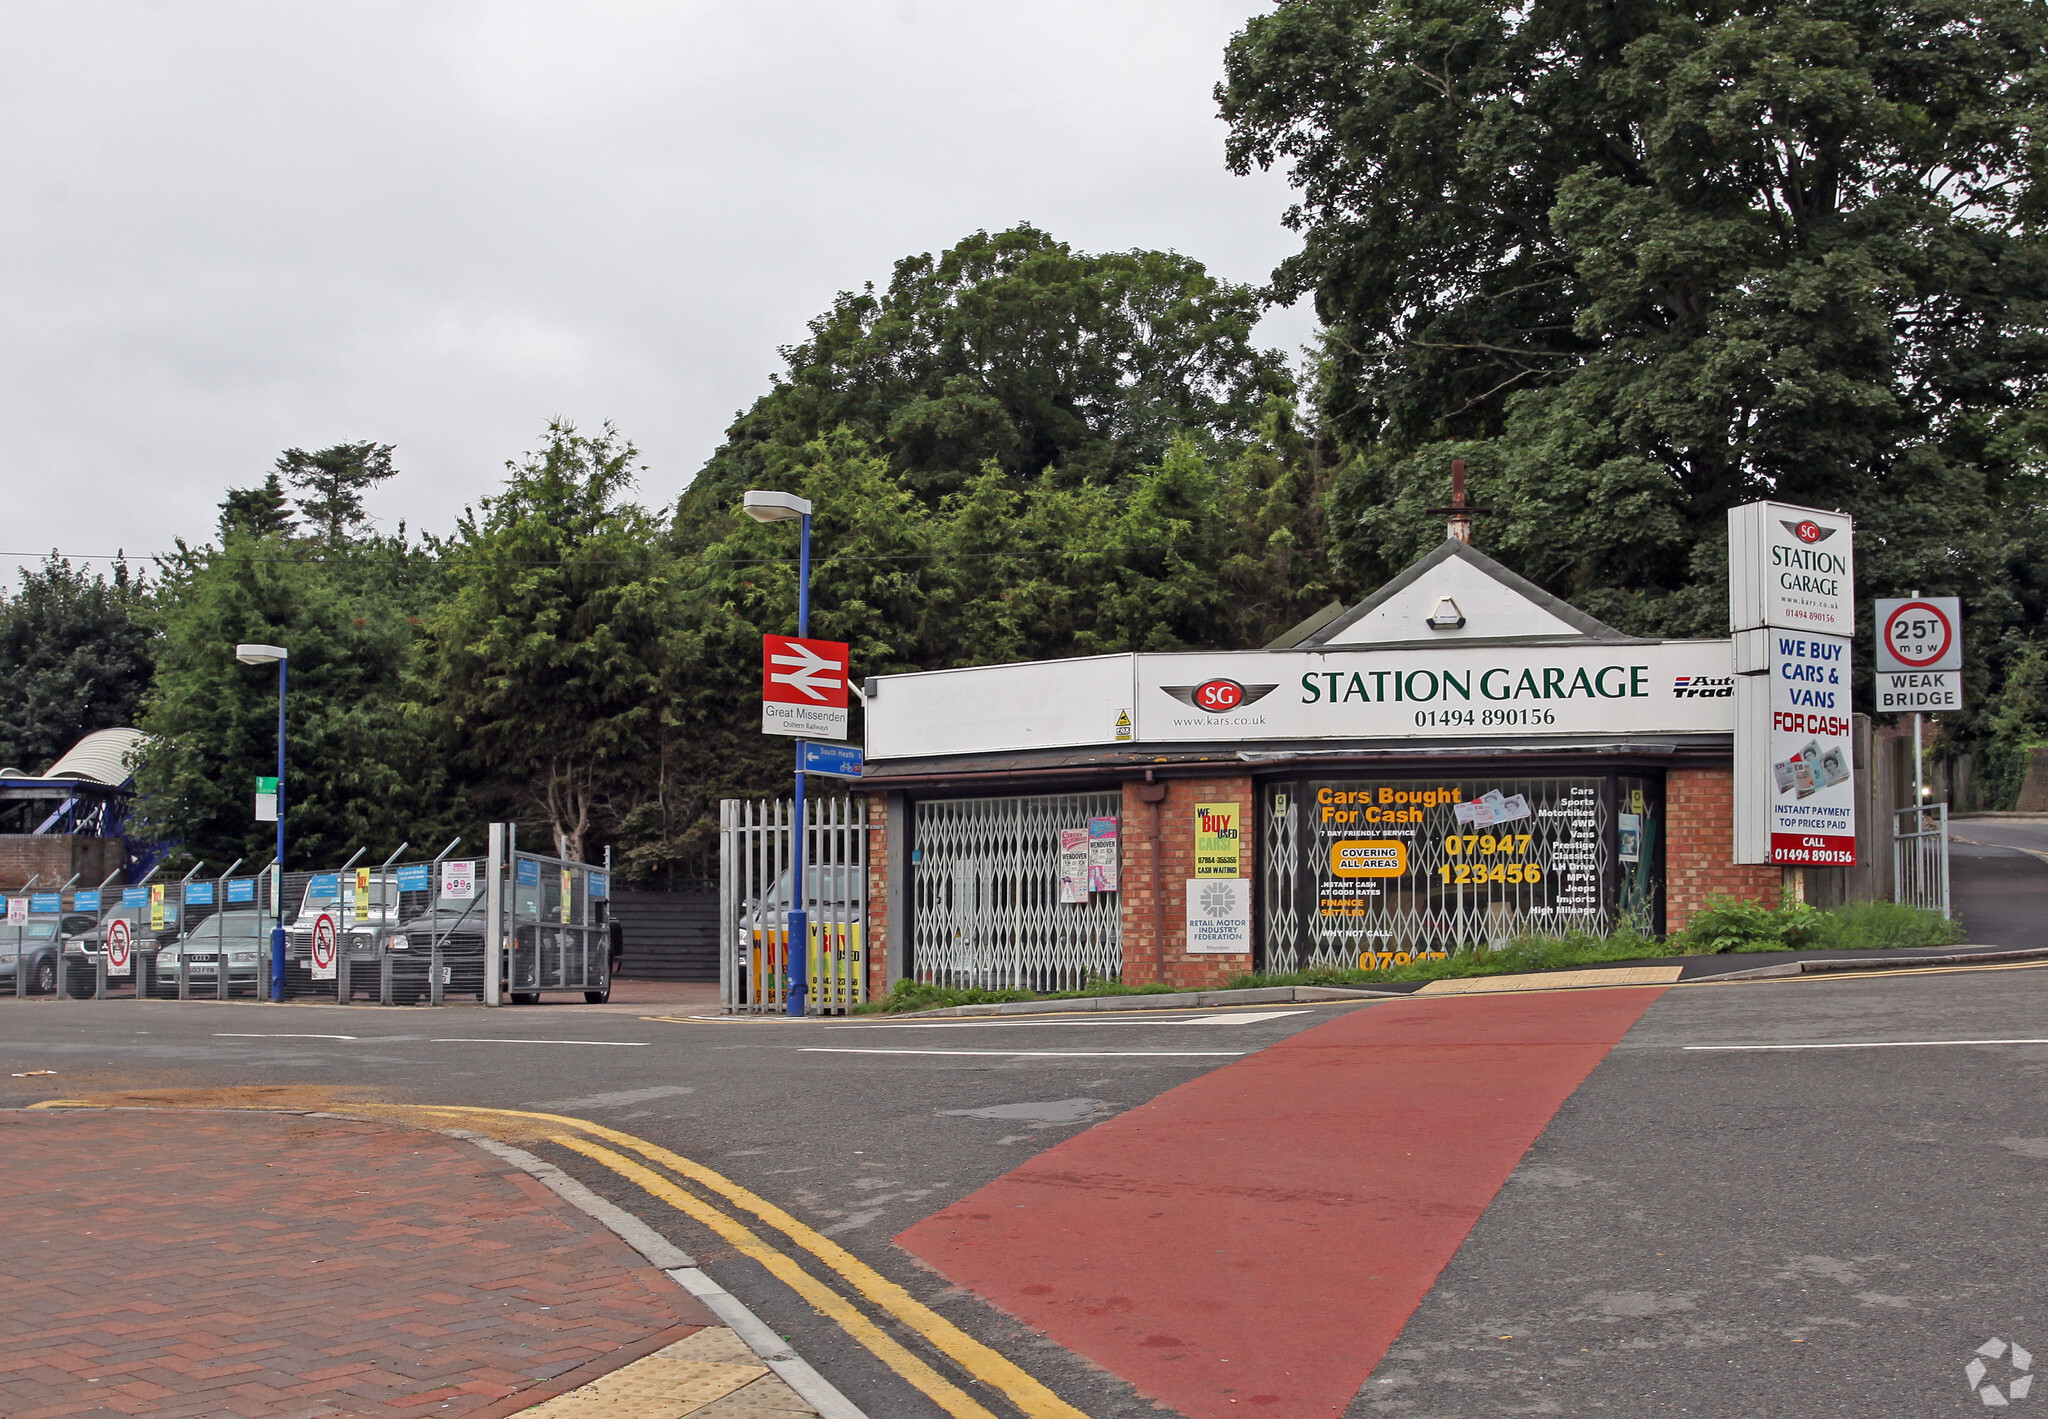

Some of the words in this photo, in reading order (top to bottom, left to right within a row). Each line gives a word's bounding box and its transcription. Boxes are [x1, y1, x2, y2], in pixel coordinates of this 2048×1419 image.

[1801, 525, 1815, 539] SG
[1772, 545, 1845, 576] STATION
[1781, 573, 1838, 596] GARAGE
[1781, 596, 1839, 610] www.kars.co.uk
[1785, 609, 1807, 619] 01494
[1809, 612, 1835, 622] 890156
[1779, 638, 1806, 657] WE
[1810, 642, 1842, 661] BUY
[1782, 663, 1823, 683] CARS
[1828, 667, 1839, 684] &
[1301, 669, 1471, 704] STATION
[1480, 665, 1649, 700] GARAGE
[1891, 674, 1945, 688] WEAK
[1205, 686, 1233, 704] SG
[1673, 687, 1734, 698] Trad
[1789, 688, 1835, 708] VANS
[1883, 692, 1954, 706] BRIDGE
[766, 705, 793, 718] Great
[796, 708, 845, 722] Missenden
[1415, 709, 1475, 727] 01494
[1482, 708, 1555, 726] 890156
[783, 721, 804, 729] Chiltern
[806, 723, 829, 731] Railways
[1173, 715, 1266, 726] www.kars.co.uk
[1774, 711, 1804, 733] FOR
[1807, 714, 1849, 737] CASH
[820, 747, 836, 756] South
[838, 750, 854, 759] Heath
[1317, 787, 1370, 804] Cars
[1378, 787, 1461, 808] Bought
[1570, 787, 1595, 795] Cars
[1561, 798, 1595, 807] Sports
[1197, 808, 1210, 818] WE
[1321, 806, 1358, 823] For
[1365, 806, 1423, 823] Cash
[1538, 809, 1595, 817] Motorbikes
[1774, 804, 1810, 815] INSTANT
[1812, 806, 1850, 817] PAYMENT
[1202, 815, 1231, 833] BUY
[1779, 818, 1796, 827] TOP
[1798, 819, 1825, 829] PRICES
[1827, 821, 1846, 830] PAID
[1218, 829, 1237, 839] USED
[1199, 838, 1231, 851] CARS!
[1445, 834, 1532, 855] 07947
[1553, 842, 1595, 851] Prestige
[1802, 837, 1825, 848] CALL
[1341, 849, 1397, 857] COVERING
[1552, 852, 1595, 860] Classics
[1775, 848, 1809, 861] 01494
[1812, 850, 1852, 863] 890156
[1340, 860, 1359, 868] ALL
[1363, 860, 1398, 868] AREAS
[1552, 863, 1566, 871] LH
[1569, 863, 1595, 871] Drive
[1438, 863, 1541, 884] 123456
[1565, 885, 1596, 893] Jeeps
[1321, 899, 1364, 907] FINANCE
[1556, 896, 1596, 904] Imports
[1321, 909, 1365, 917] SETTLED
[1530, 906, 1553, 916] High
[1556, 906, 1596, 916] Mileage
